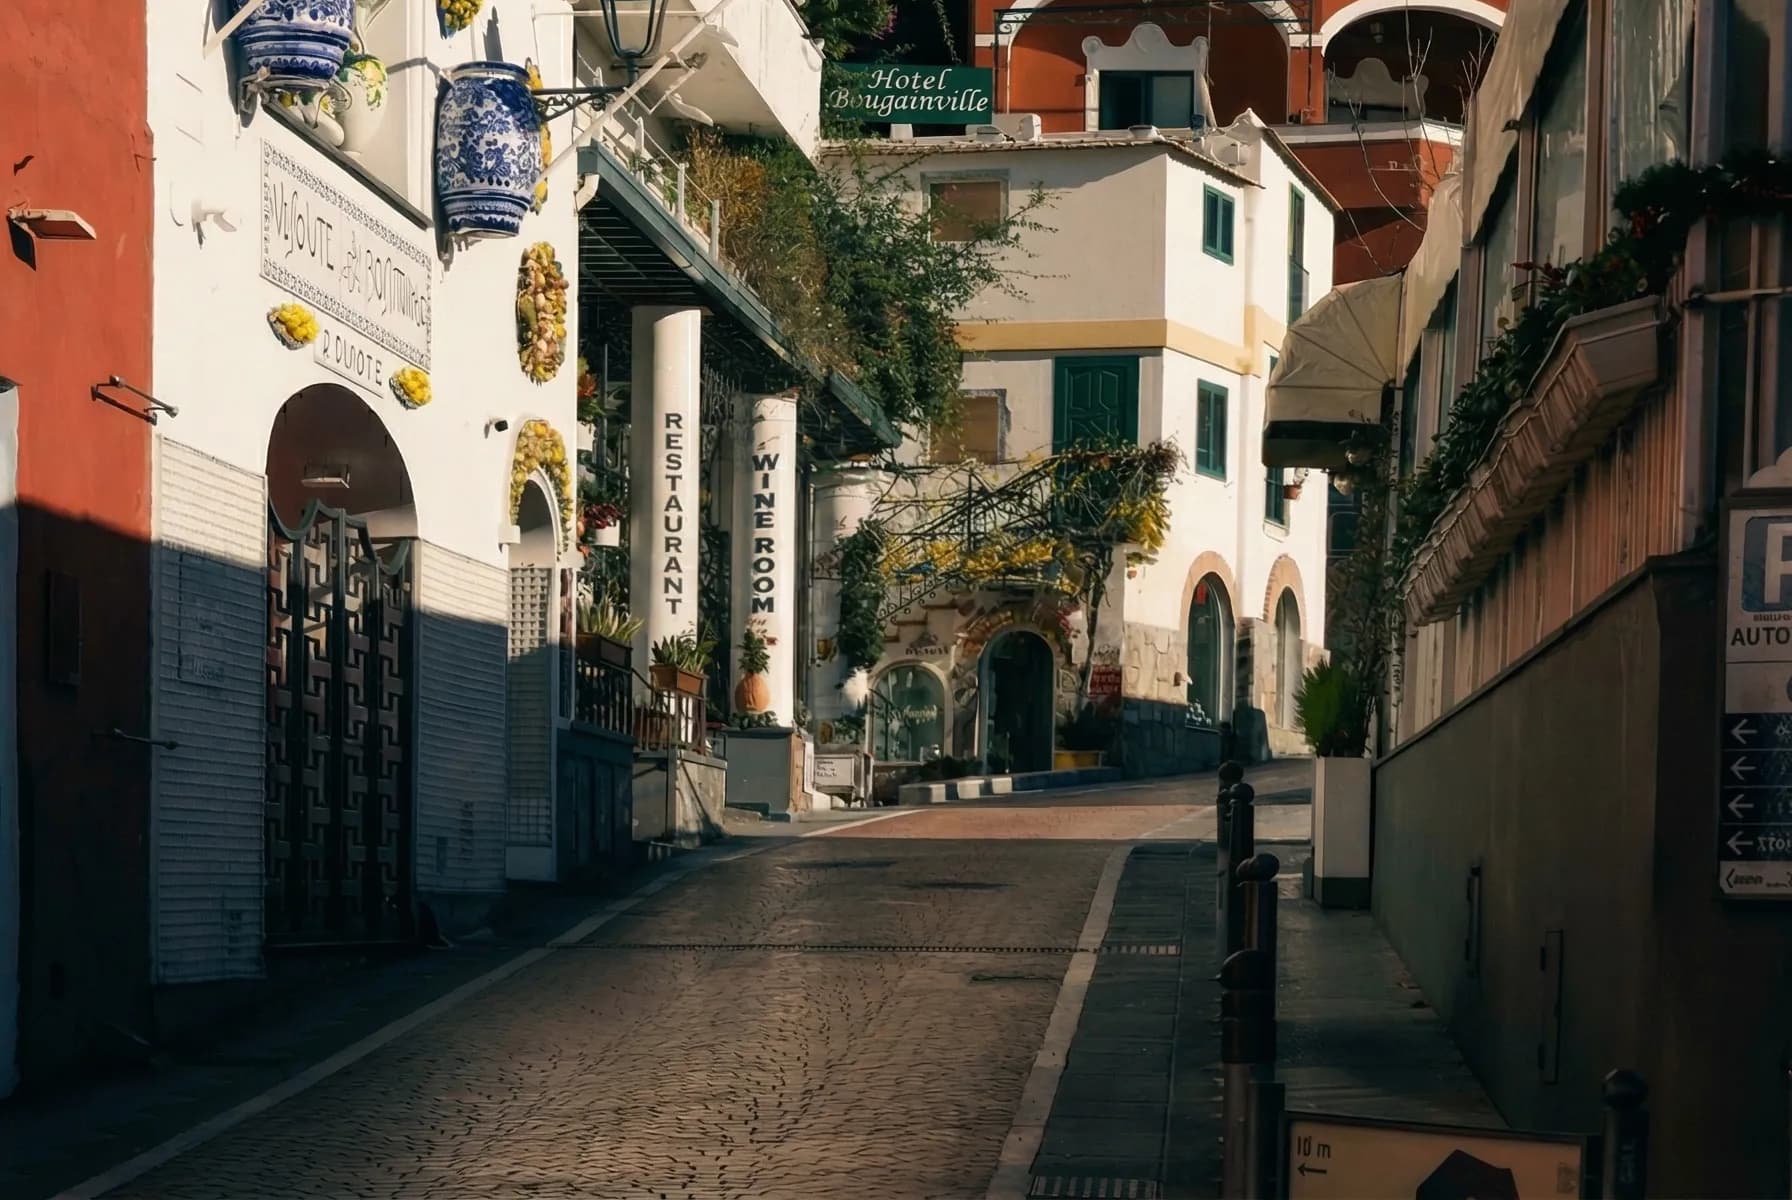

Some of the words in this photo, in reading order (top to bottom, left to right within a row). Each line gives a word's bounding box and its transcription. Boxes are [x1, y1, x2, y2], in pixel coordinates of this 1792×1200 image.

[829, 87, 989, 118] Bougainville
[867, 67, 953, 90] Hotel
[663, 412, 684, 615] RESTAURANT
[752, 453, 780, 530] WINE
[752, 537, 775, 614] ROOM
[1731, 626, 1791, 647] AUTO
